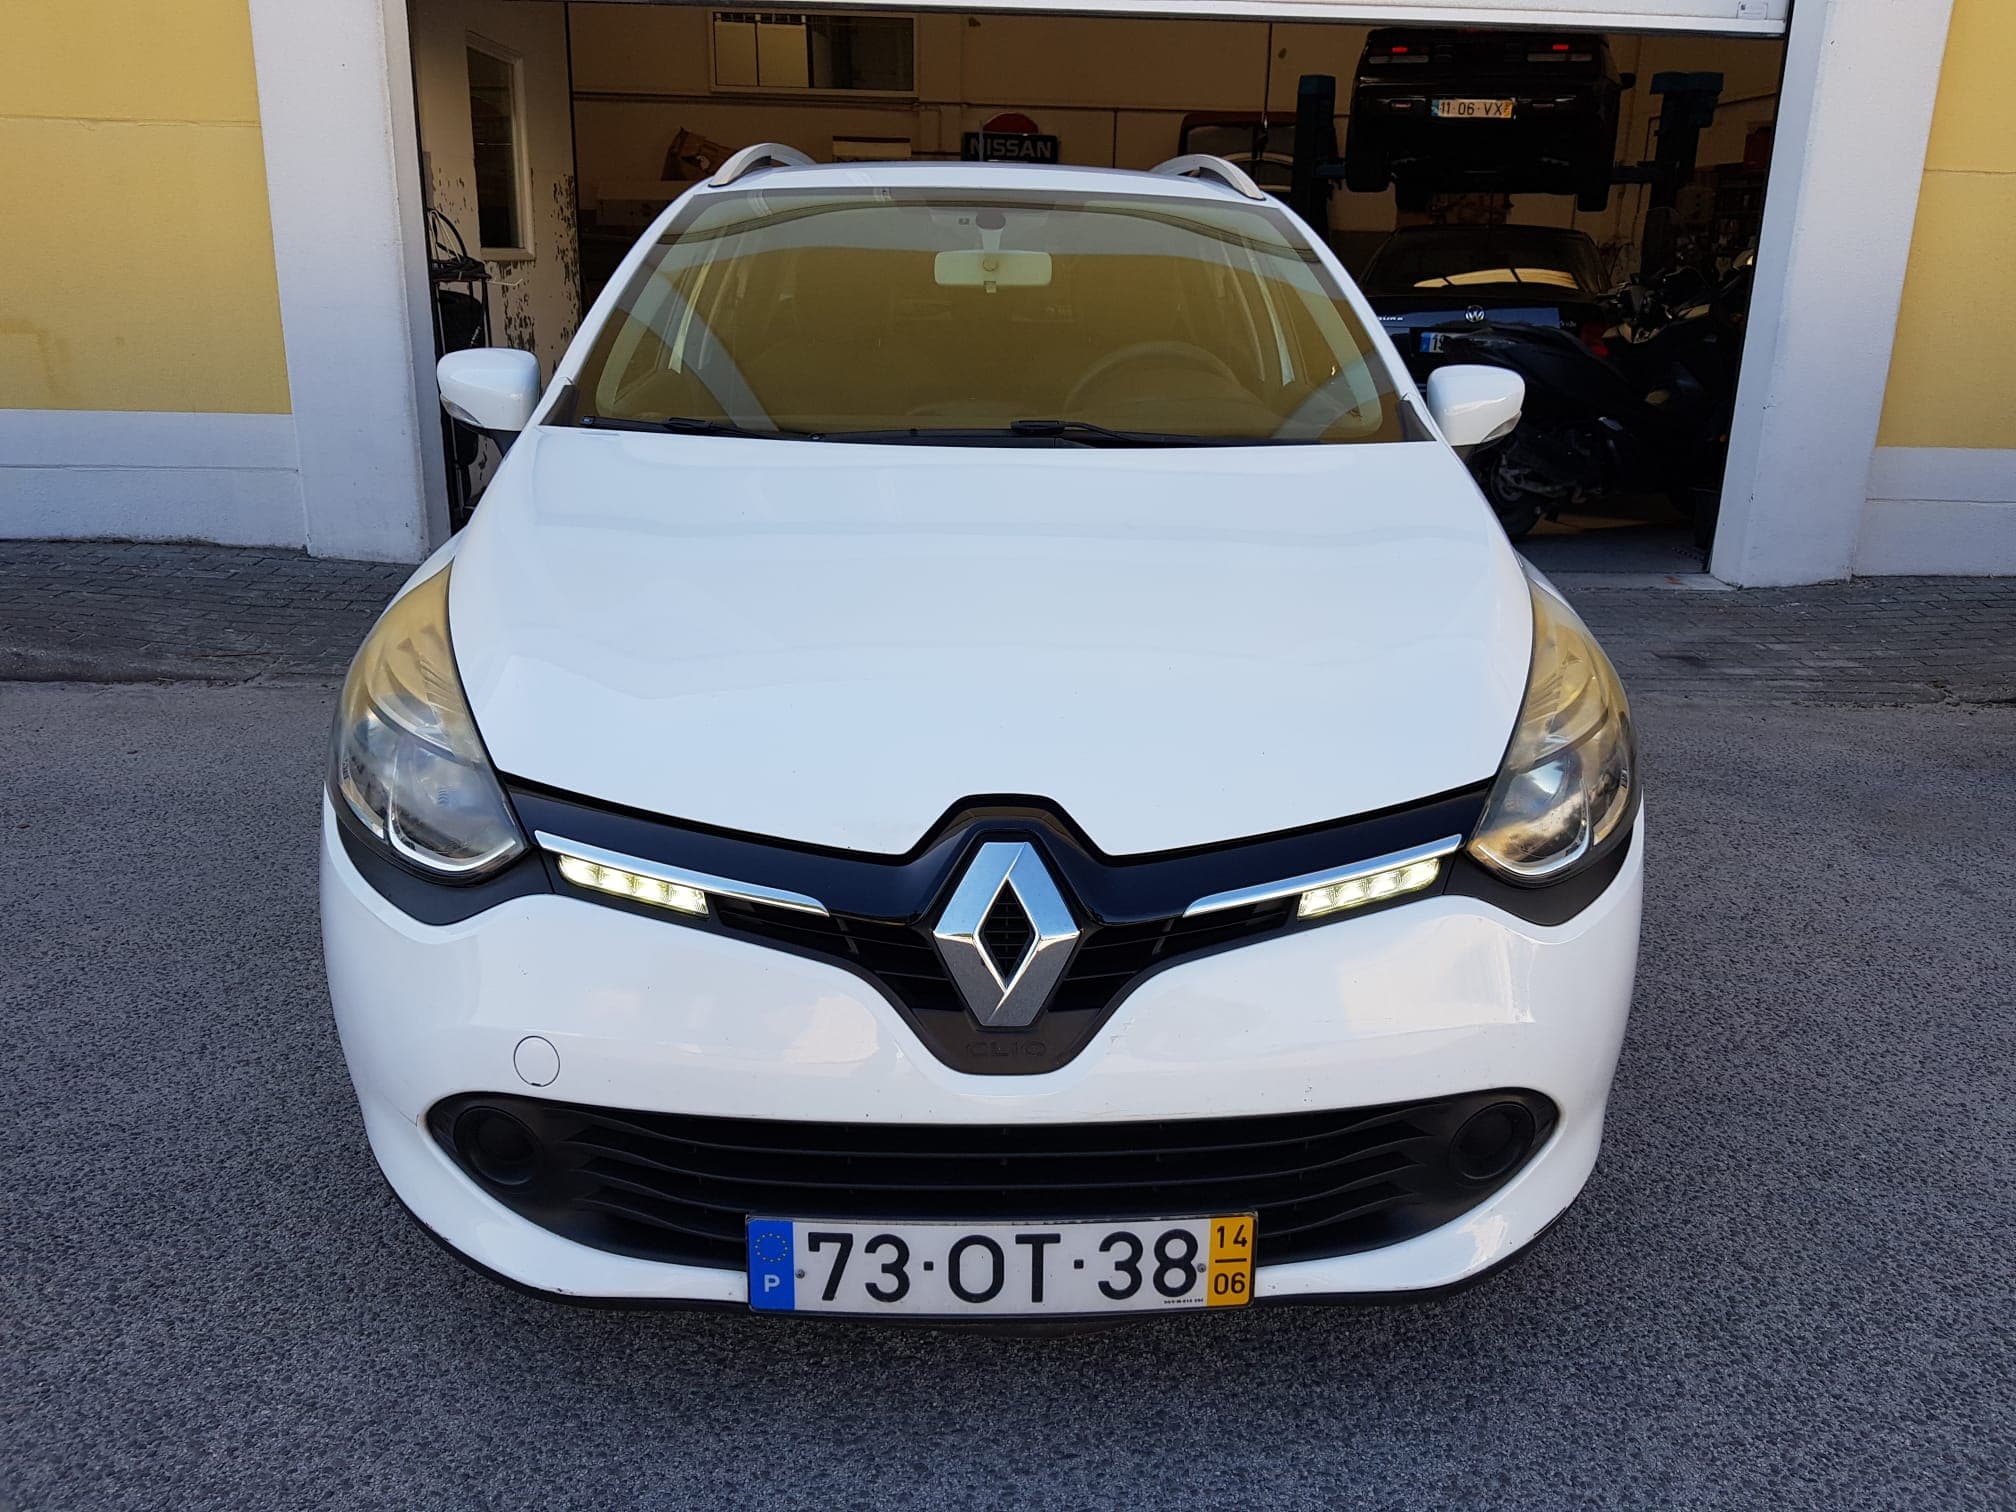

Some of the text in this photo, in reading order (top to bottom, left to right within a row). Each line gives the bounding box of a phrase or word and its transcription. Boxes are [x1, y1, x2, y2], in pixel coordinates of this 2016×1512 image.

[969, 137, 1053, 159] NISSAN
[968, 1041, 1047, 1057] CLIO
[1216, 1224, 1248, 1248] 14
[763, 1274, 781, 1293] P
[1214, 1272, 1246, 1295] 06
